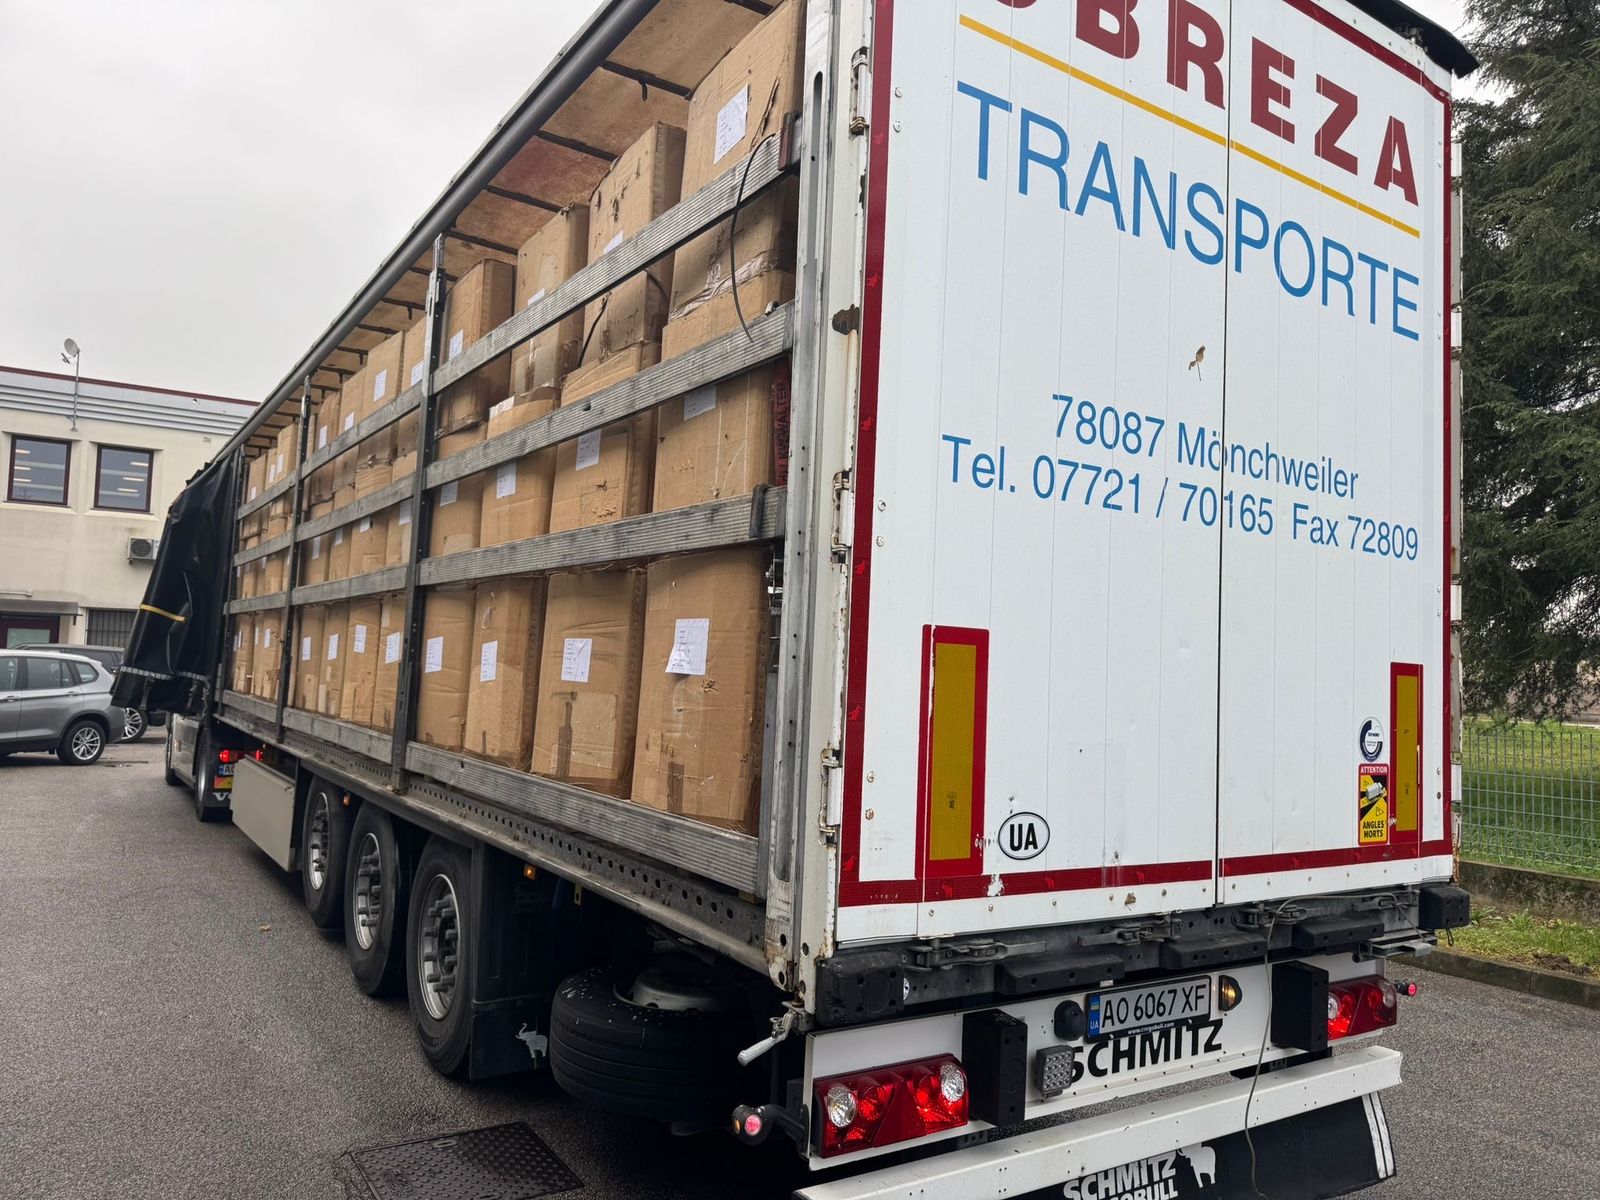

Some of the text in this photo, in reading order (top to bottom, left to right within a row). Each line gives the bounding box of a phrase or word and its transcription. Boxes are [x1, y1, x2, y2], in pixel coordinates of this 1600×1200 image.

[957, 80, 1420, 341] TRANSPORTE
[1052, 394, 1359, 499] 78087 Mönchweiler
[942, 435, 1419, 561] Tel. 07721 / 70165 Fax 72809
[1360, 766, 1388, 774] ATTENTION
[1009, 822, 1039, 851] UA
[1362, 820, 1385, 830] ANGLES
[1363, 829, 1384, 839] MORTS
[1101, 983, 1207, 1029] AO 6067 XF
[1090, 1020, 1099, 1030] UA
